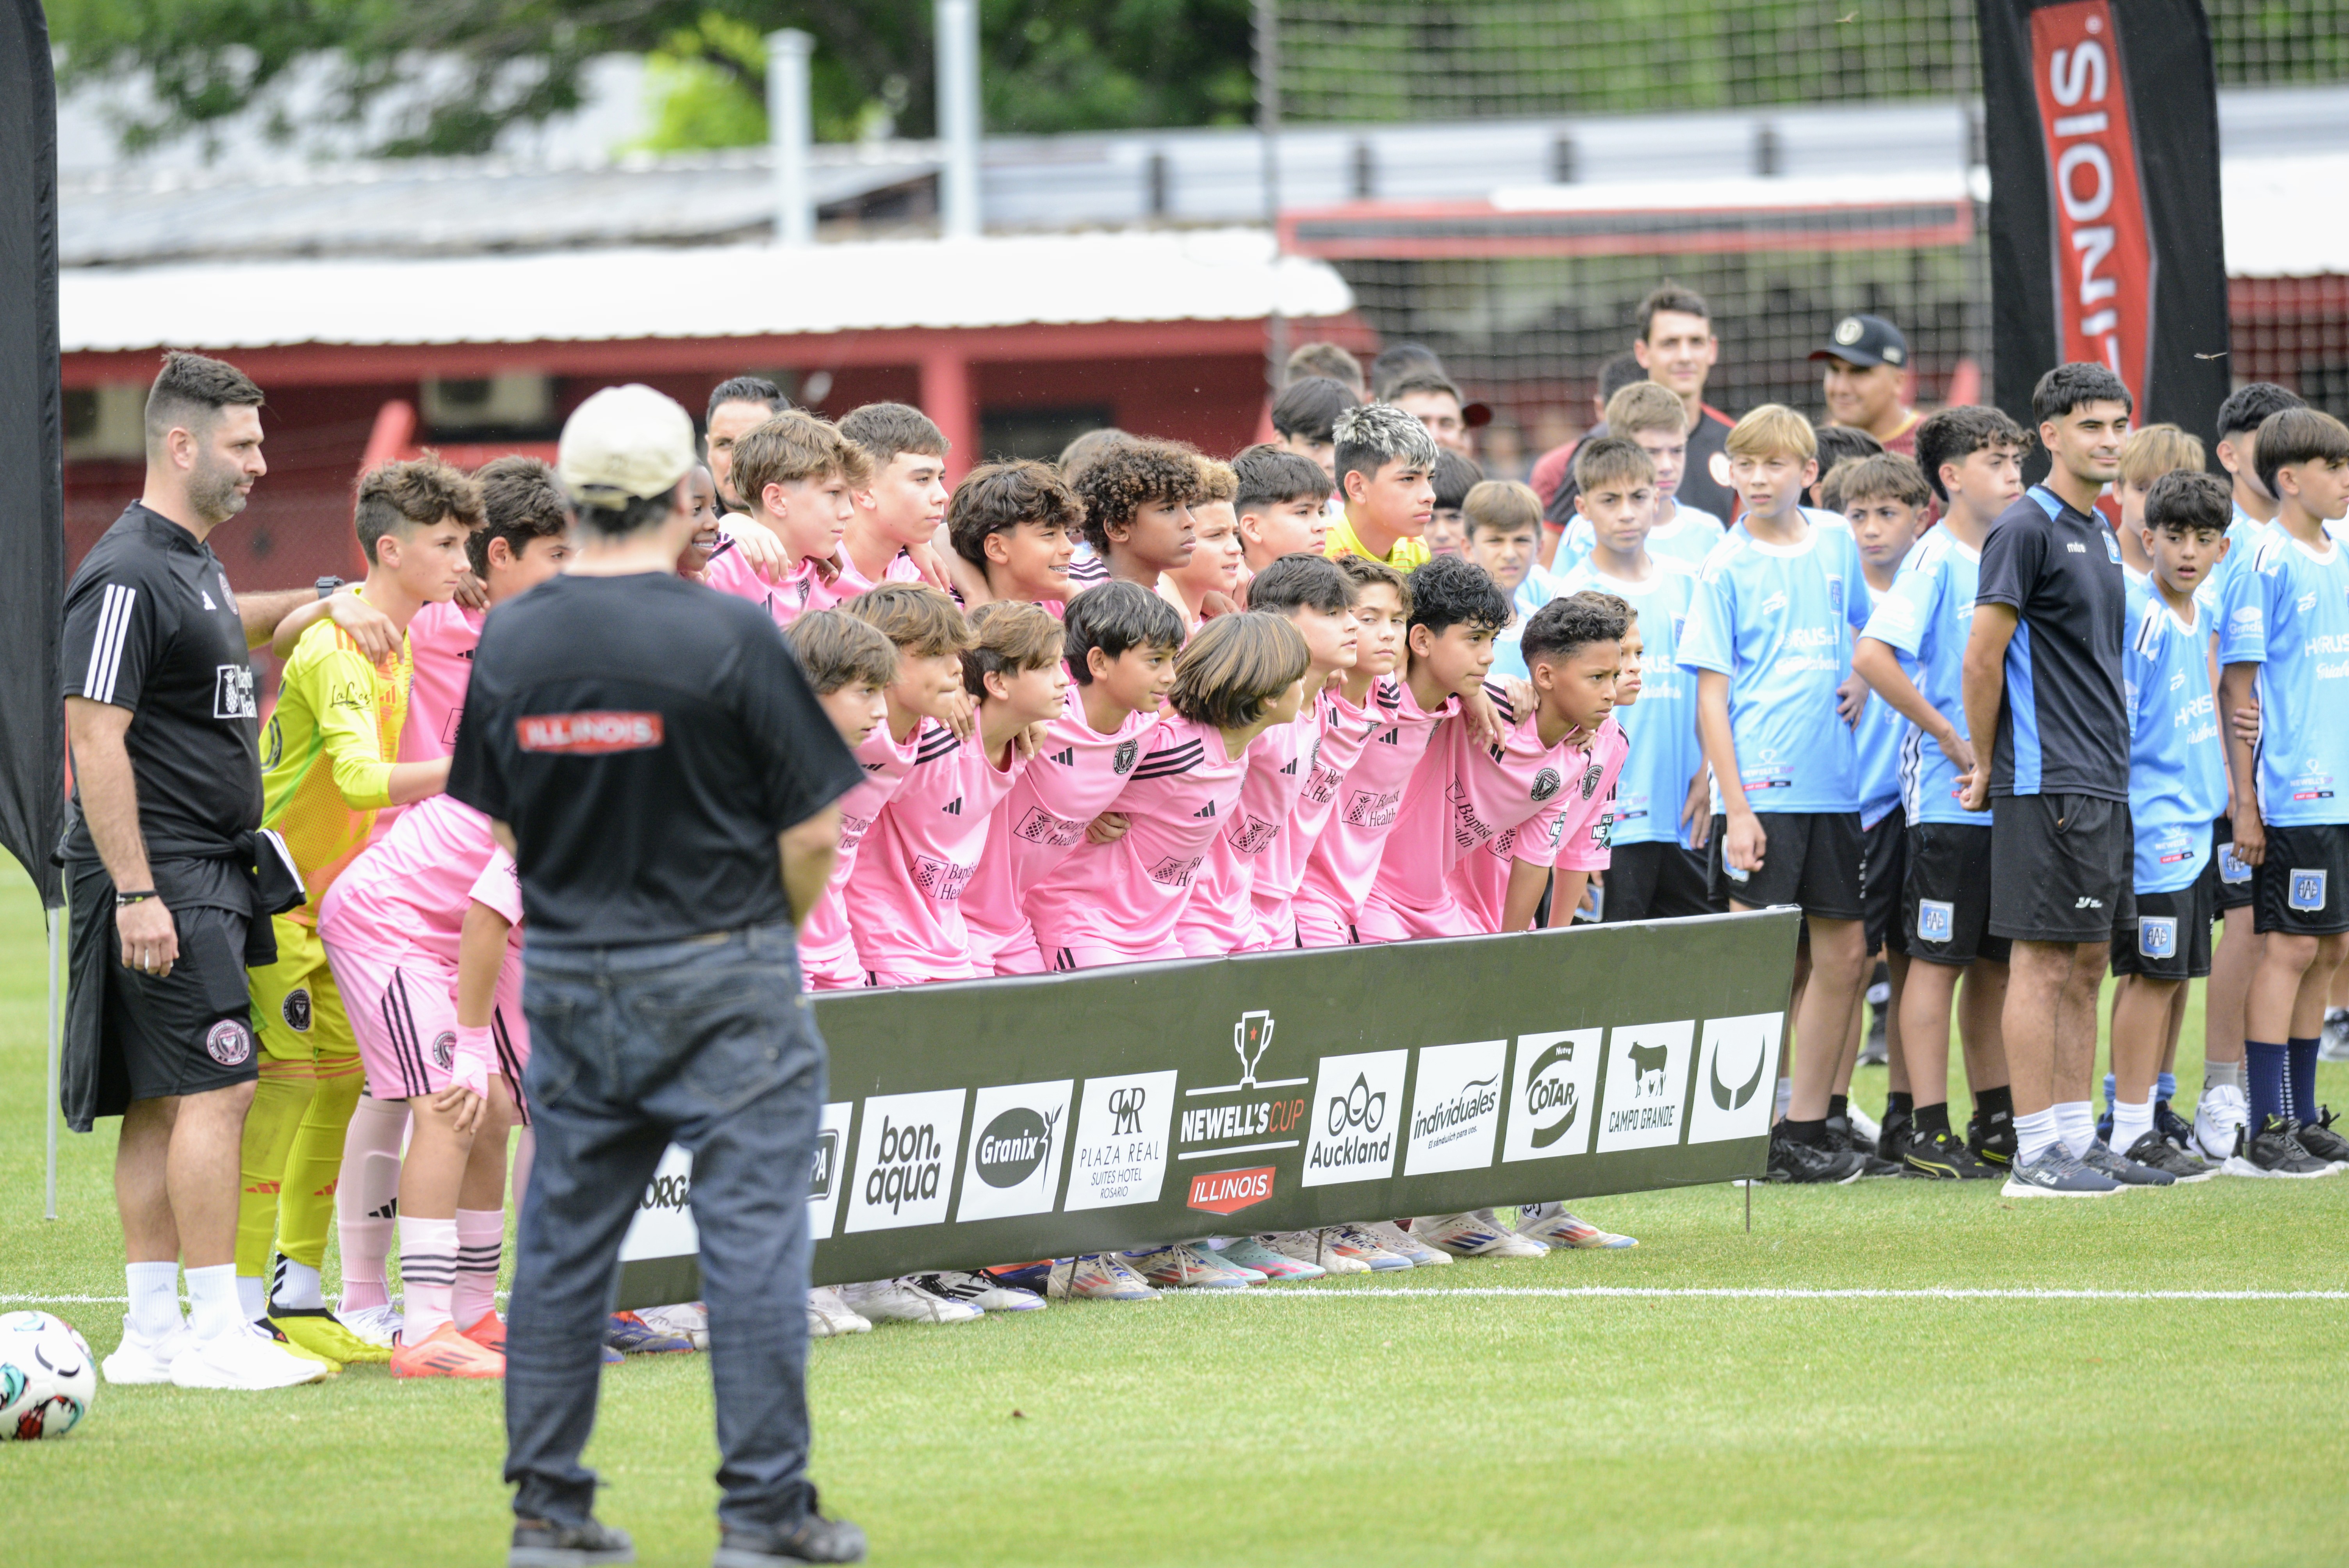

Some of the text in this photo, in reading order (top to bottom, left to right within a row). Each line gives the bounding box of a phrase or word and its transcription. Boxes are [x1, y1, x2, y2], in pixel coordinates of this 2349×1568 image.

[1640, 655, 1671, 674] RUS
[526, 716, 653, 747] ILLINOIS
[1544, 775, 1555, 784] MIAMI
[1368, 808, 1395, 827] Health
[1457, 802, 1495, 839] Baptist
[1455, 828, 1475, 848] alth
[1180, 1098, 1305, 1143] NEWELL'S CUP
[1413, 1089, 1496, 1140] individuales
[1609, 1105, 1675, 1133] CAMPO GRANDE
[981, 1129, 1039, 1165] Granix
[1456, 1130, 1467, 1141] para
[1080, 1140, 1159, 1168] PLAZA REAL
[1309, 1132, 1391, 1169] Auckland
[866, 1162, 941, 1216] aqua
[1091, 1167, 1142, 1186] SUITES HOTEL
[1193, 1174, 1267, 1203] ILLINOIS
[2034, 1171, 2058, 1185] FILA
[1100, 1186, 1128, 1199] ROSARIO
